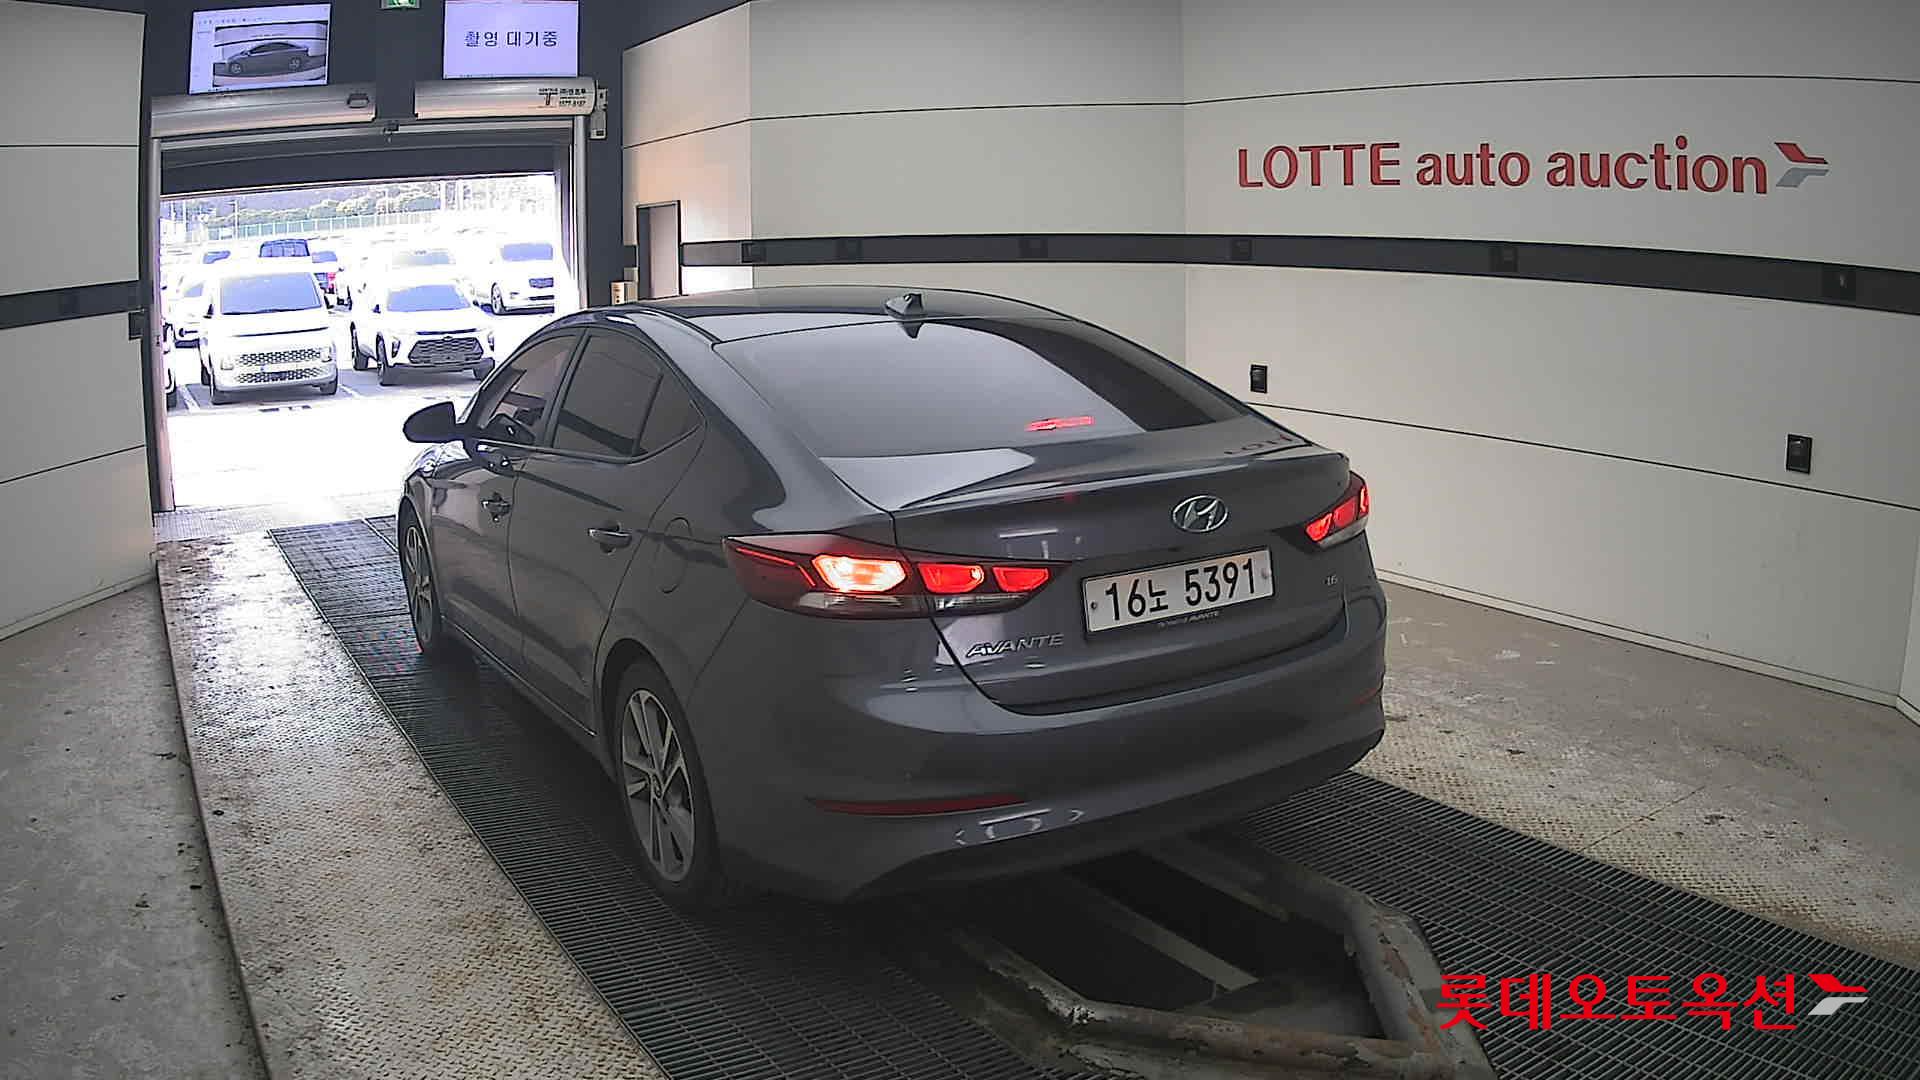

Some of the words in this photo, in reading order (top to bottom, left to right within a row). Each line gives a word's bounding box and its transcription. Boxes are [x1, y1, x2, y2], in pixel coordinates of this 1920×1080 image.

[506, 31, 558, 48] 대기중
[1238, 143, 1401, 189] LOTTE
[1416, 143, 1531, 188] auto
[1546, 135, 1768, 195] auction
[1105, 578, 1169, 621] 16노
[1184, 557, 1255, 607] 5391
[966, 634, 1065, 658] AVANTE
